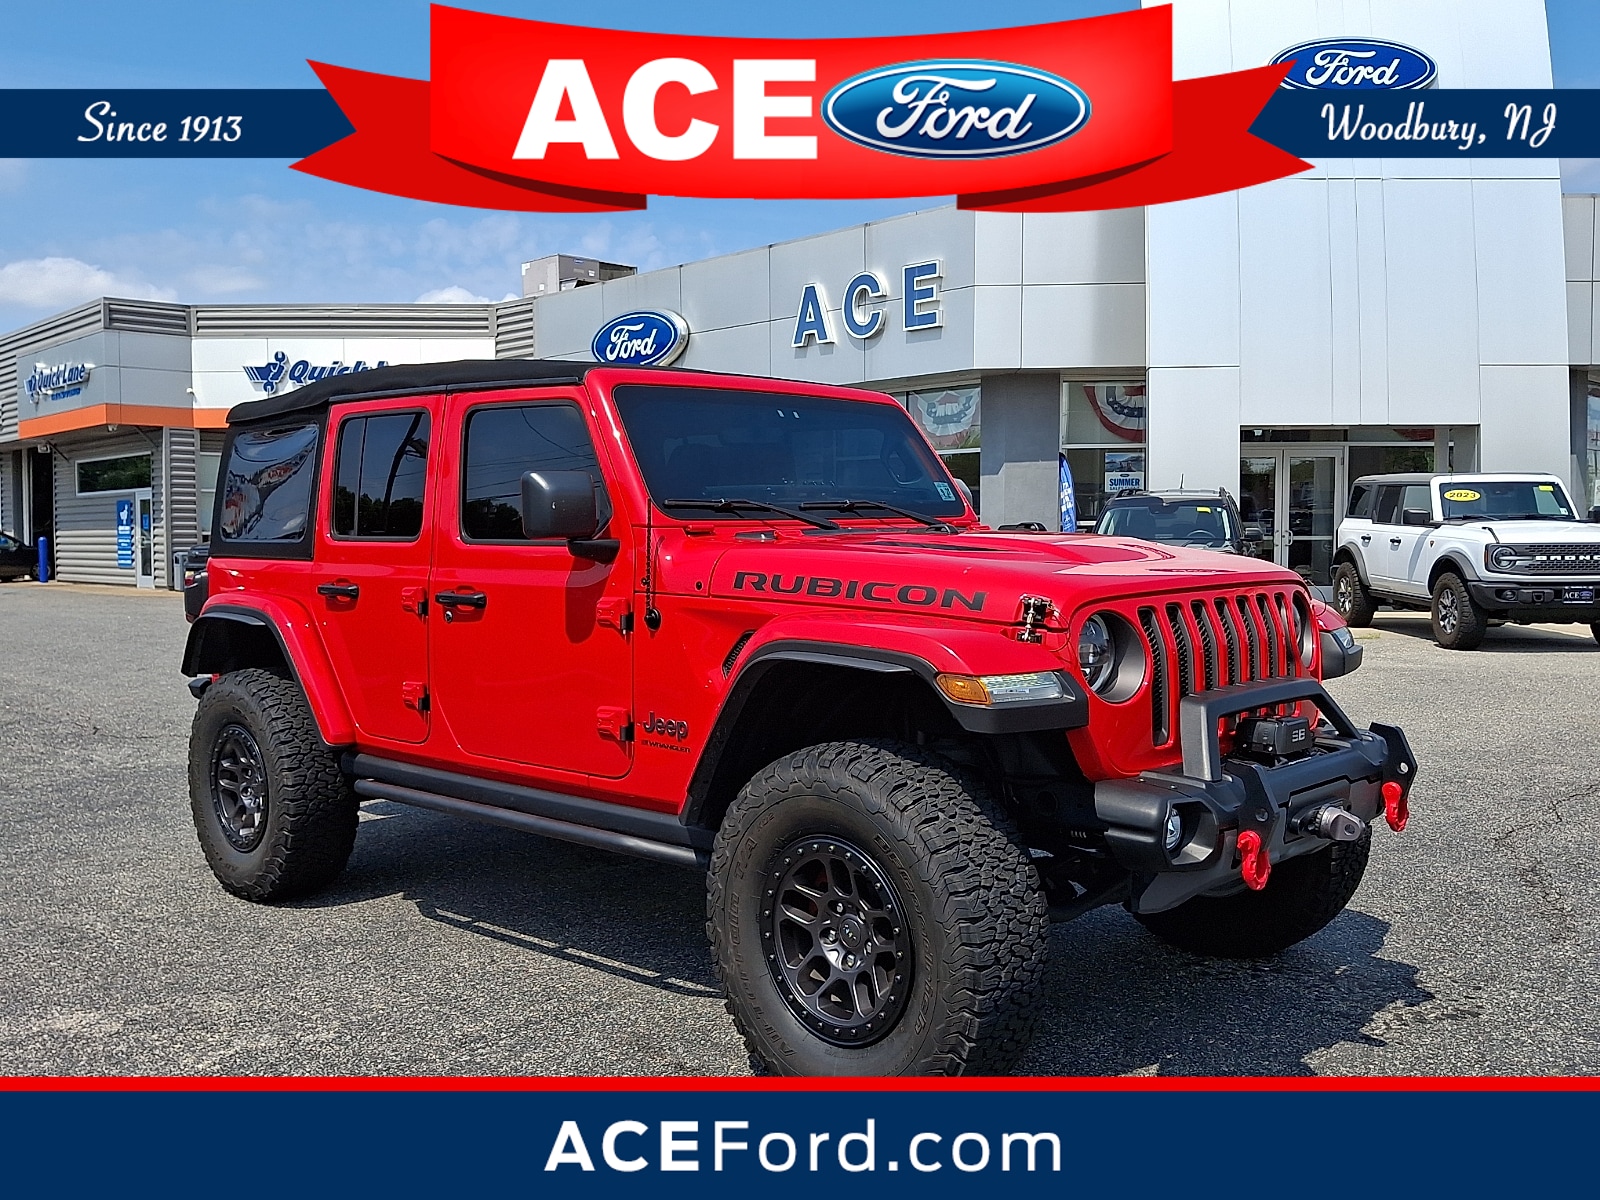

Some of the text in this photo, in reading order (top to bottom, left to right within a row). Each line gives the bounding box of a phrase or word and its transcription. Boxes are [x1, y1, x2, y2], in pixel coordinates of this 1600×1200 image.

[1305, 49, 1401, 86] Ford
[791, 259, 945, 348] ACE
[605, 322, 657, 361] Ford
[1109, 478, 1140, 487] SUMMER
[1449, 491, 1477, 499] 2023
[733, 571, 988, 613] RUBICON
[1563, 591, 1580, 599] ACE
[642, 711, 689, 742] Jeep
